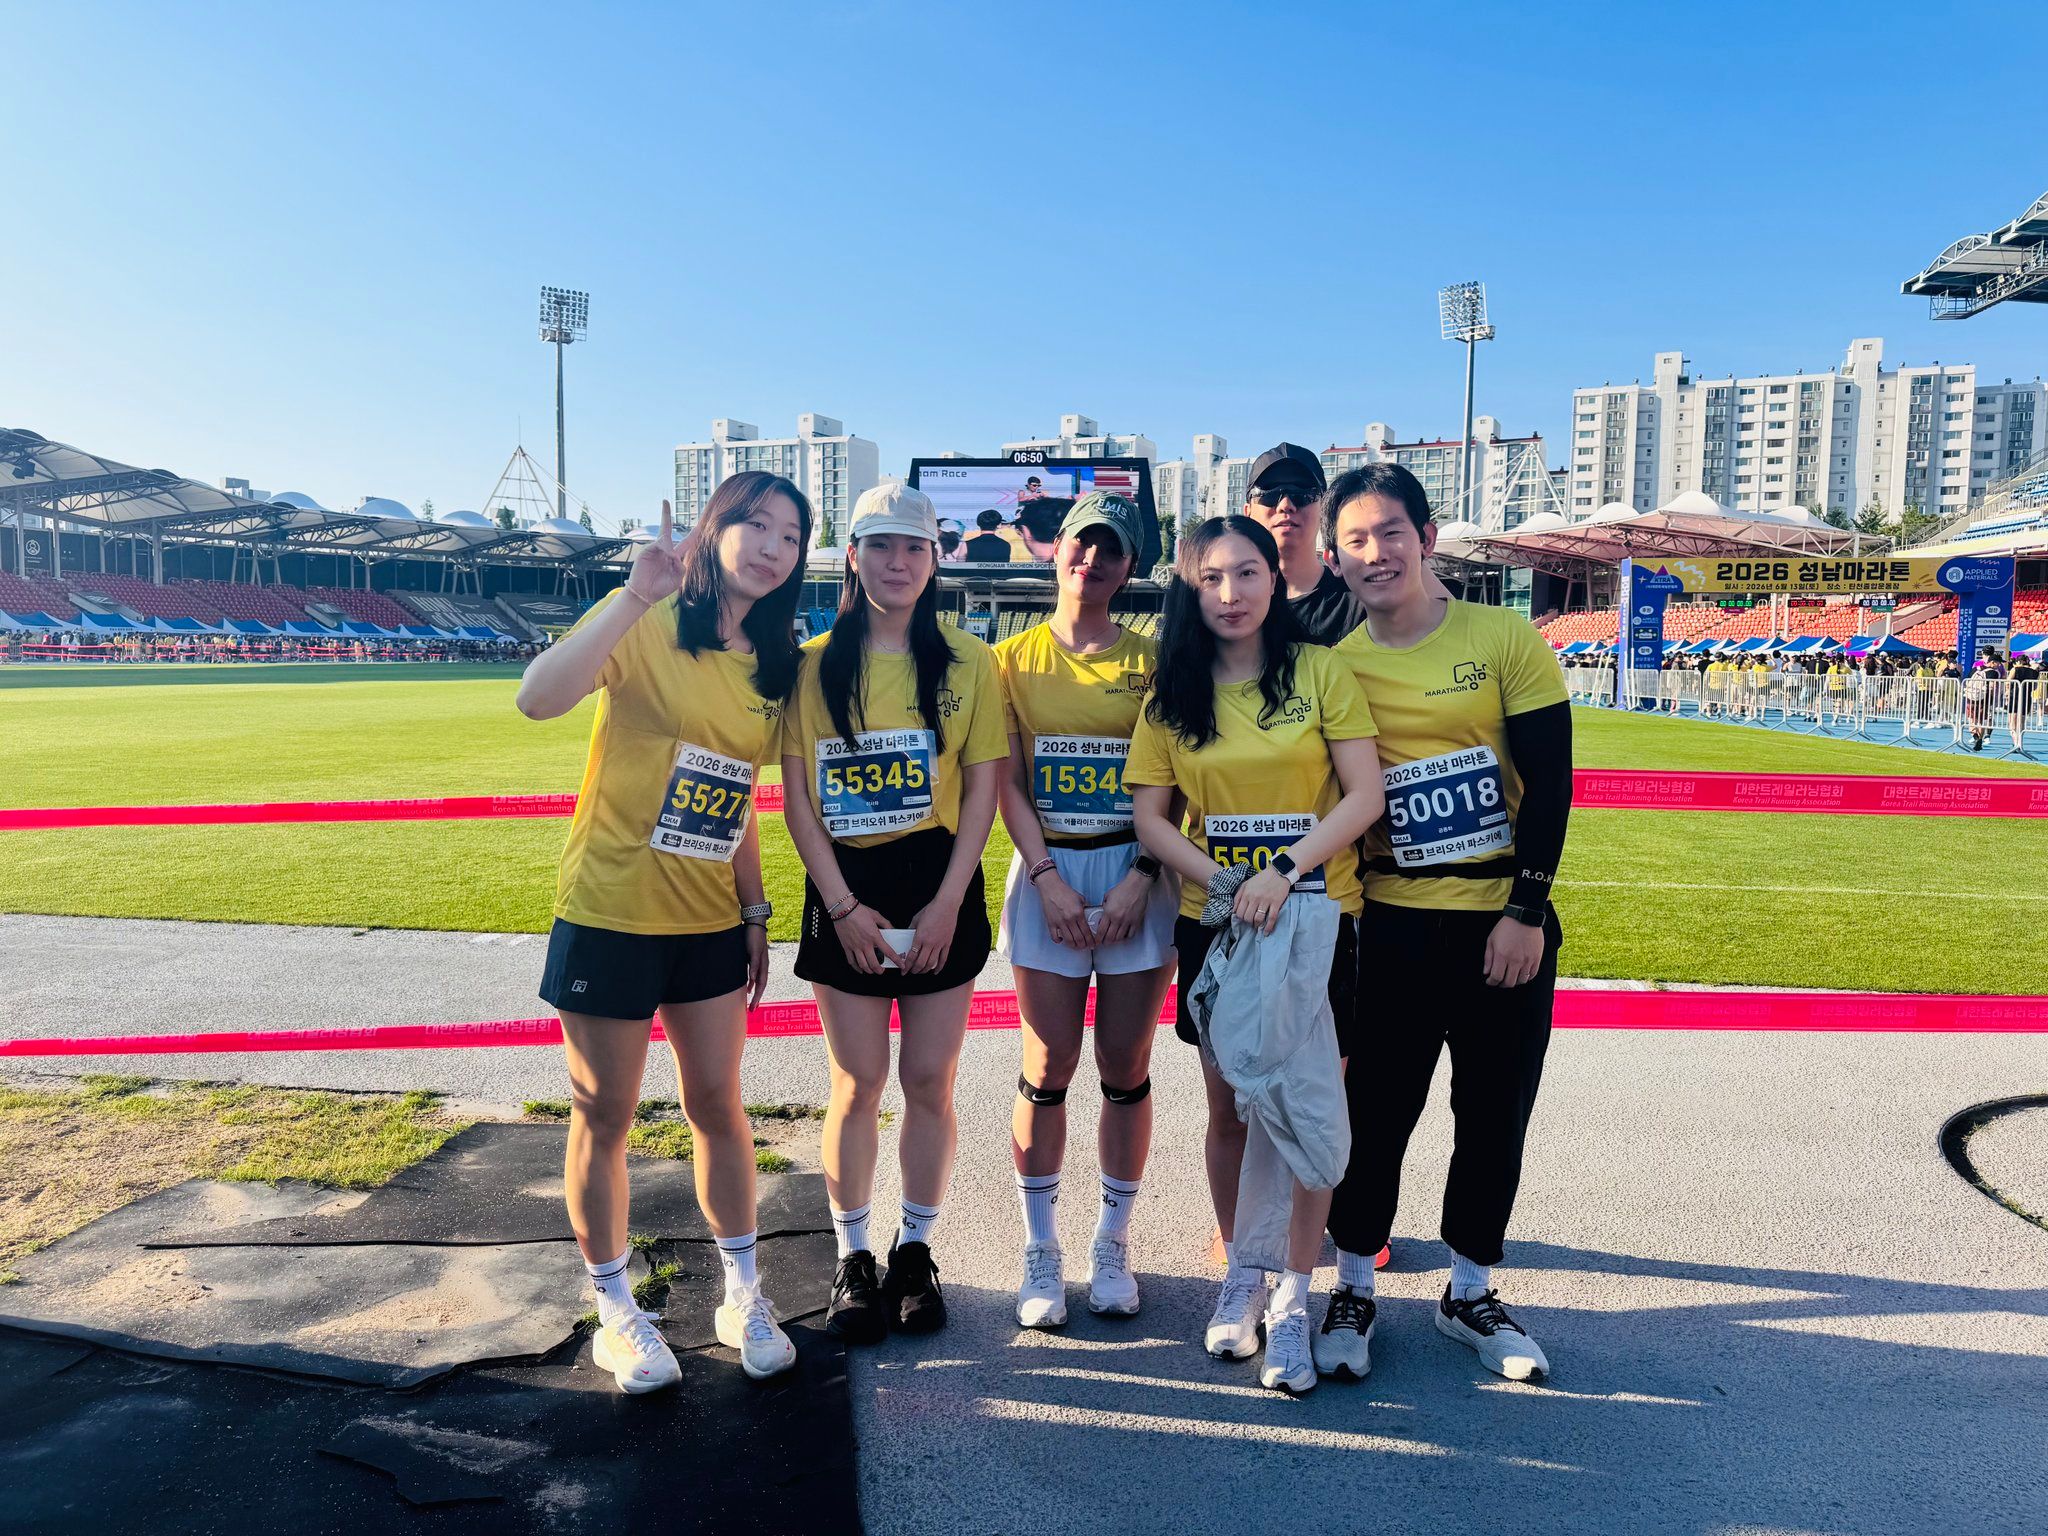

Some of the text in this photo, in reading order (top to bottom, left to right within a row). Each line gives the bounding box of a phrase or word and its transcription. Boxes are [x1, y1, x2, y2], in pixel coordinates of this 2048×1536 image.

[1013, 452, 1043, 464] 06:50
[941, 469, 968, 478] Race
[1716, 561, 1911, 582] 2026 성남마라톤
[1424, 685, 1468, 698] MARATHON
[862, 737, 884, 751] 성남
[886, 734, 920, 748] 마라톤
[1041, 741, 1077, 753] 2026
[1080, 742, 1102, 755] 성남
[685, 752, 721, 772] 2026
[722, 762, 741, 777] 성남
[1384, 750, 1489, 786] 2026 성남 마라톤
[825, 759, 925, 796] 55345
[1584, 779, 1695, 794] 대한트레일러닝협회
[1734, 782, 1844, 798] 대한트레일러닝협회
[1883, 786, 1992, 801] 대한트레일러닝협회
[1388, 776, 1500, 828] 50018
[1582, 793, 1693, 803] Korea Trail Running Association
[1732, 796, 1841, 807] Korea Trail Running Association
[1880, 799, 1989, 810] Korea Trail Running Association
[492, 804, 573, 813] Korea Trail Running
[824, 804, 839, 812] 5KM
[663, 815, 679, 826] 5KM
[851, 816, 886, 828] 브리오쉬
[1212, 818, 1312, 833] 2026 성남 마라톤
[682, 837, 712, 853] 브리오쉬
[1393, 834, 1409, 843] 5KM
[1425, 840, 1466, 857] 브리오쉬
[763, 1008, 820, 1023] 대한트레
[723, 1256, 734, 1268] lo
[594, 1282, 607, 1294] lo
